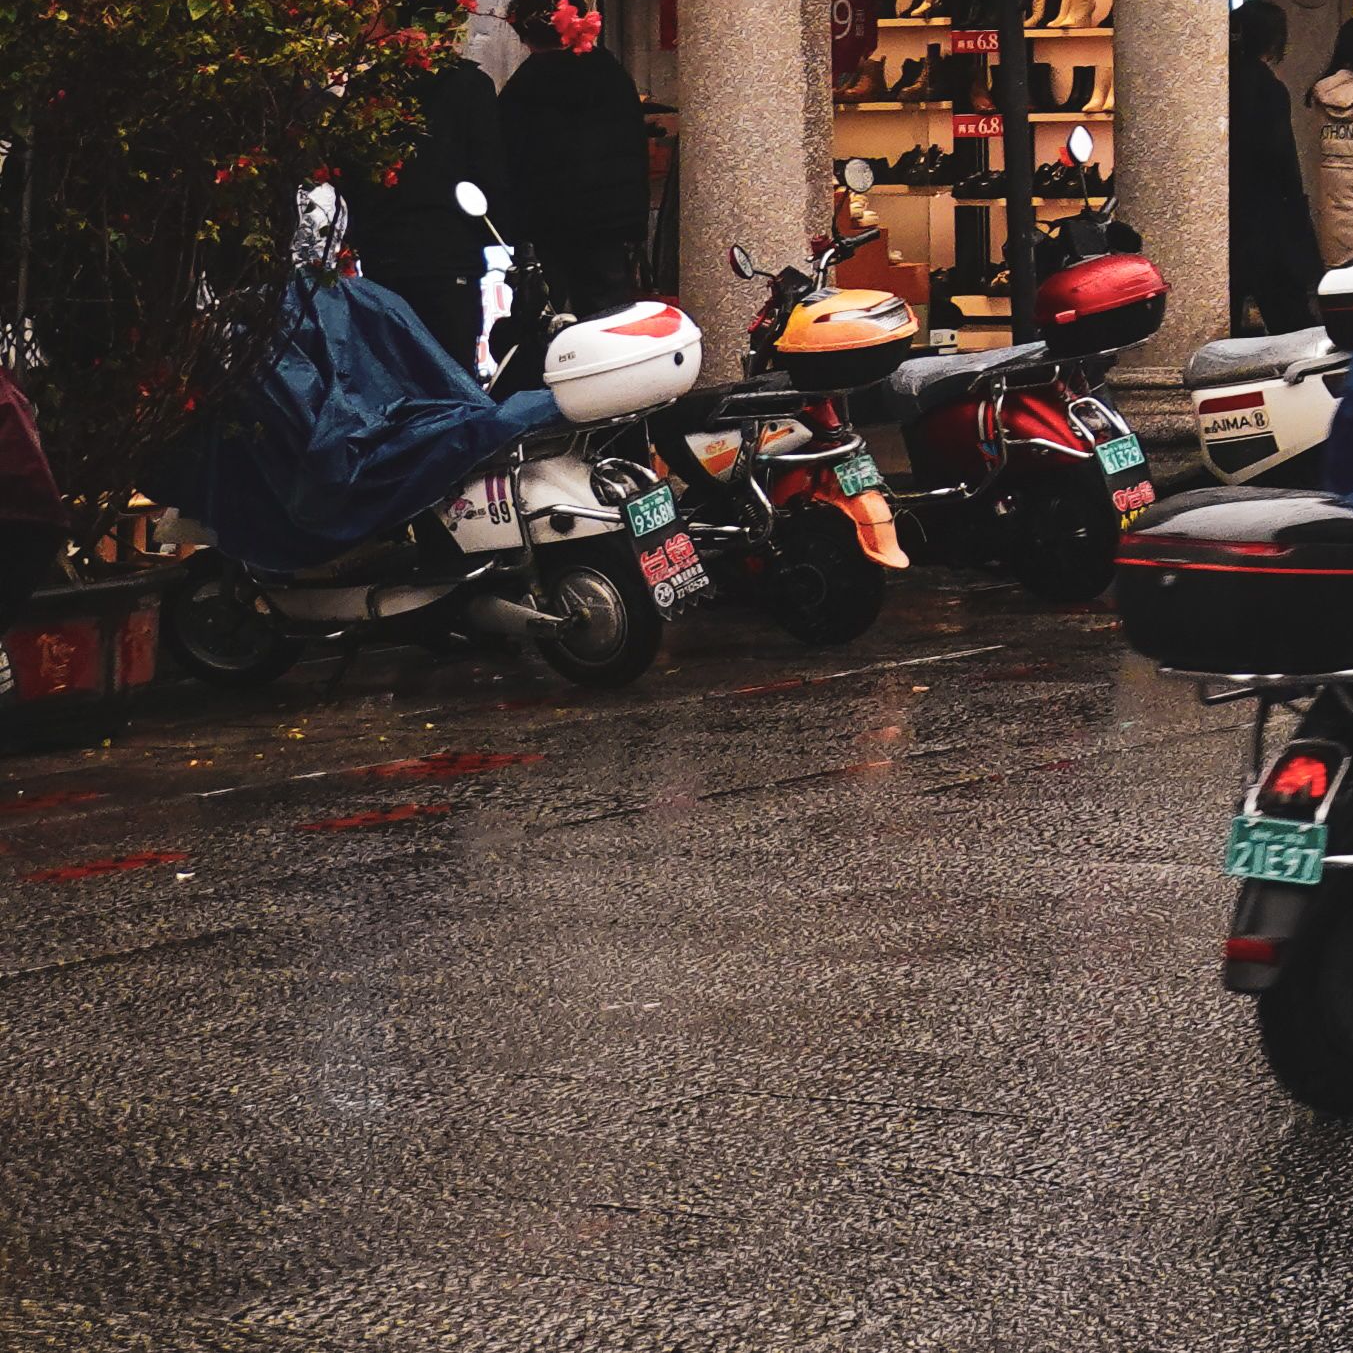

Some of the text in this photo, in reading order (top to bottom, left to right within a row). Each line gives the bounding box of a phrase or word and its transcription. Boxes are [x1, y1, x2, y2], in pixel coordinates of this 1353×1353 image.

[976, 33, 999, 50] 6.8
[978, 117, 1000, 135] 6.8
[488, 500, 511, 525] 99
